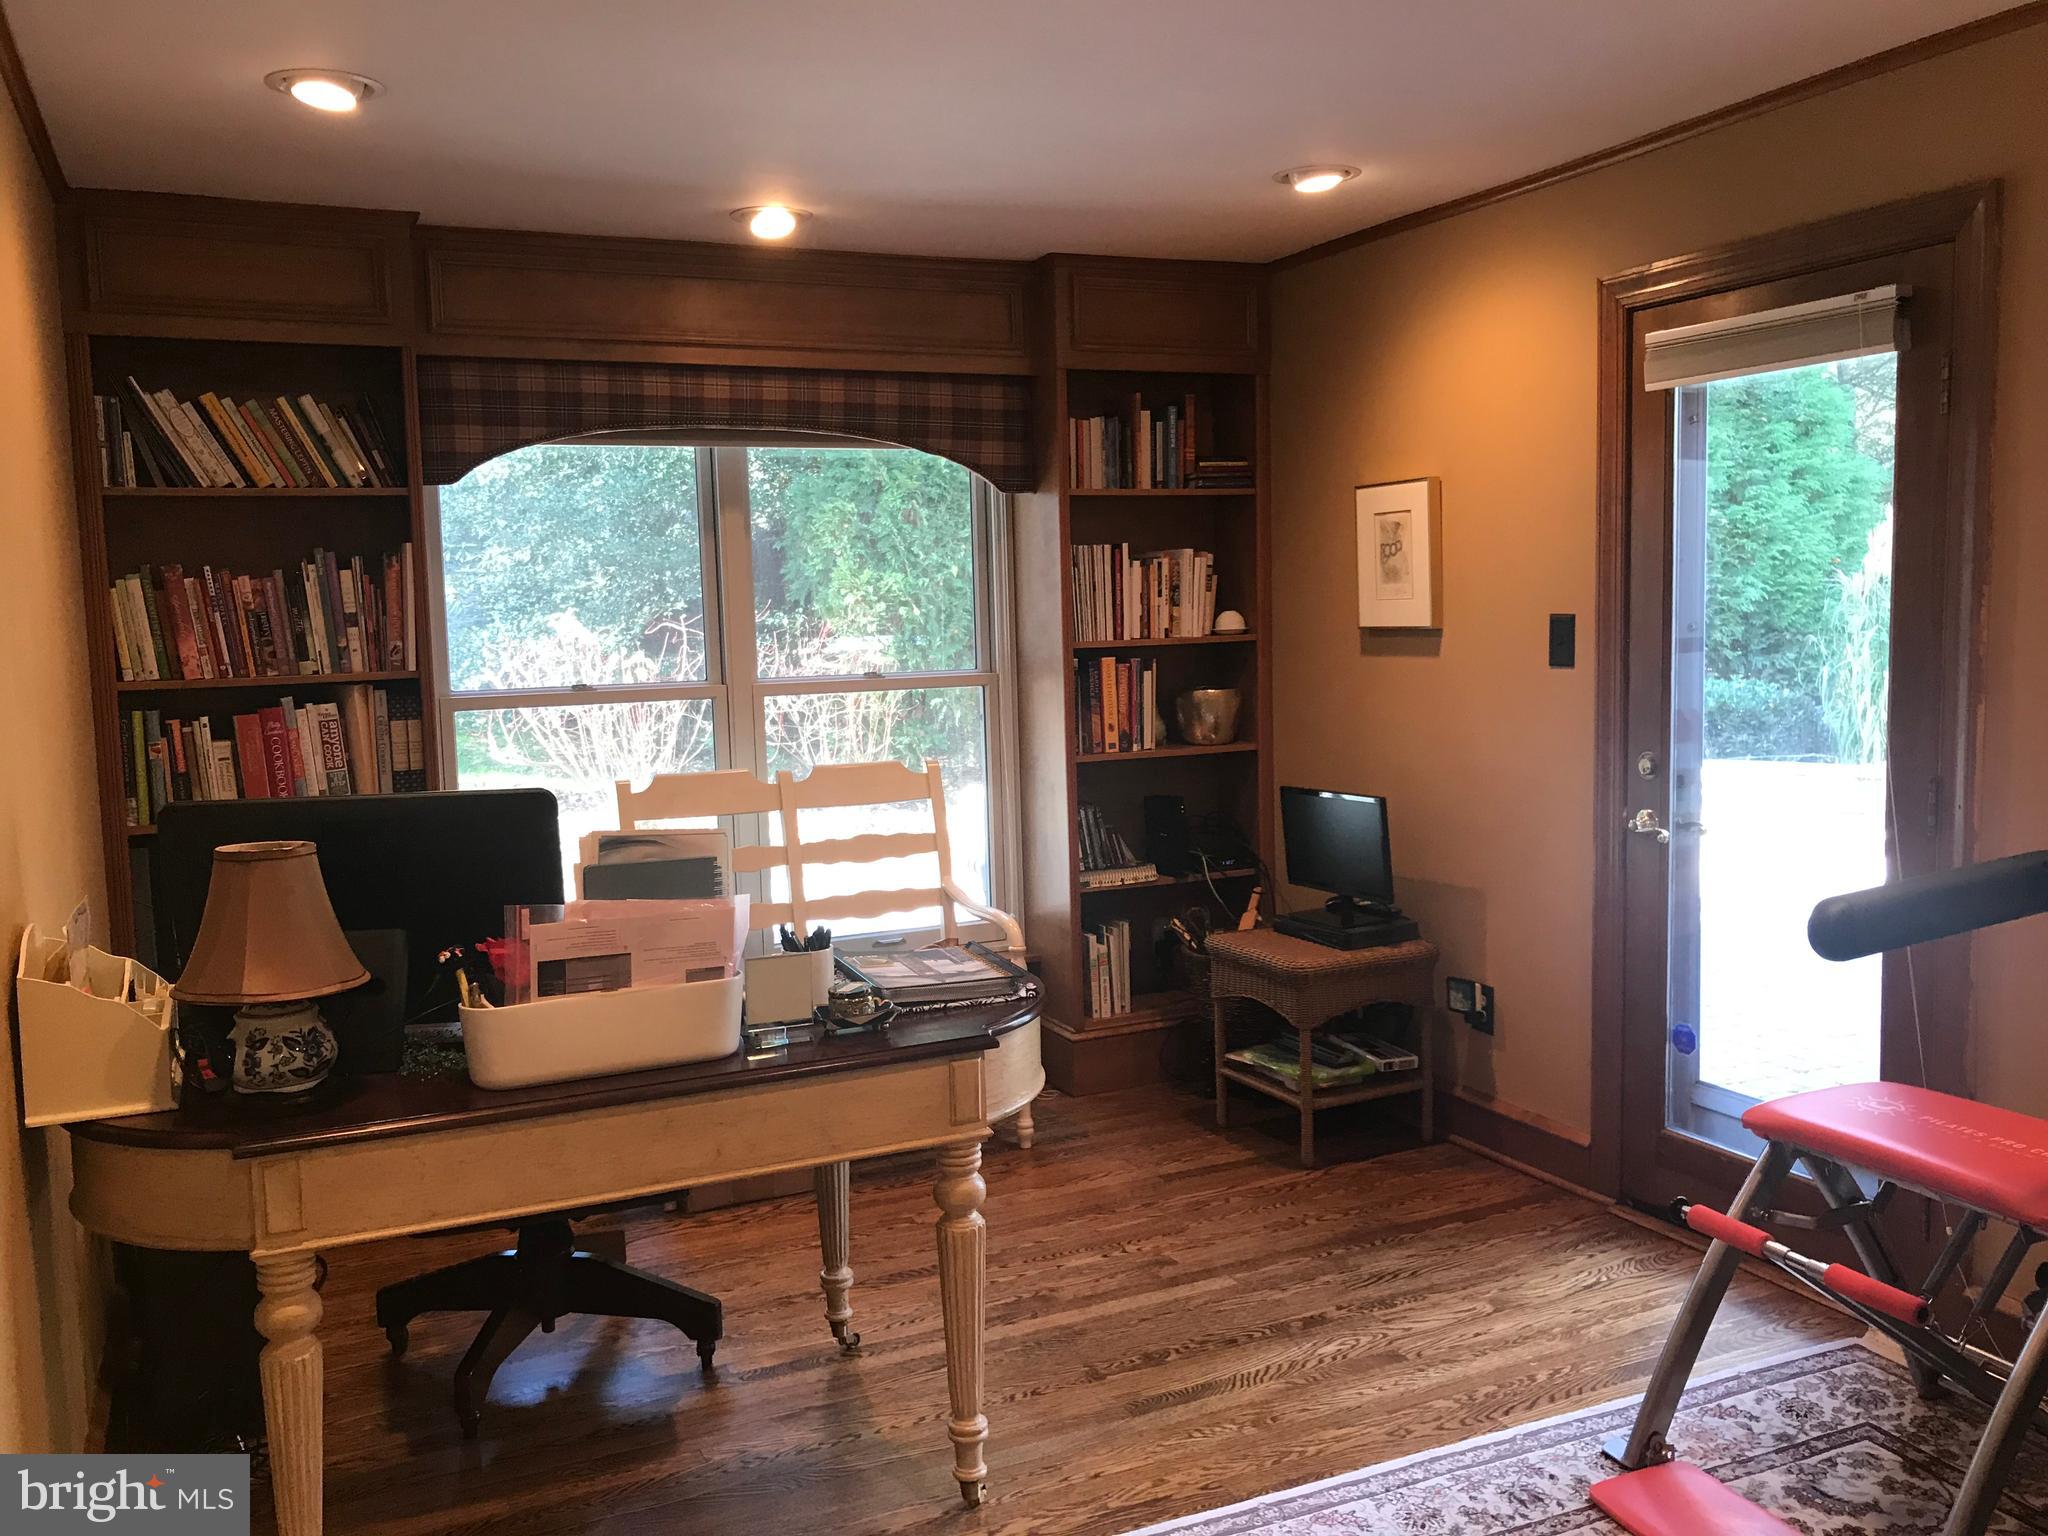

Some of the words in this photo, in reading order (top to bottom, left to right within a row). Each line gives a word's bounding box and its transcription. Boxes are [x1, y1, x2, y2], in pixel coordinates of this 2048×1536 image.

[268, 407, 297, 450] MASTERING
[320, 721, 330, 741] CAN
[329, 720, 343, 768] anyone
[324, 744, 335, 769] COOK
[1920, 1115, 1988, 1136] PILATES
[1989, 1137, 2027, 1149] PRO
